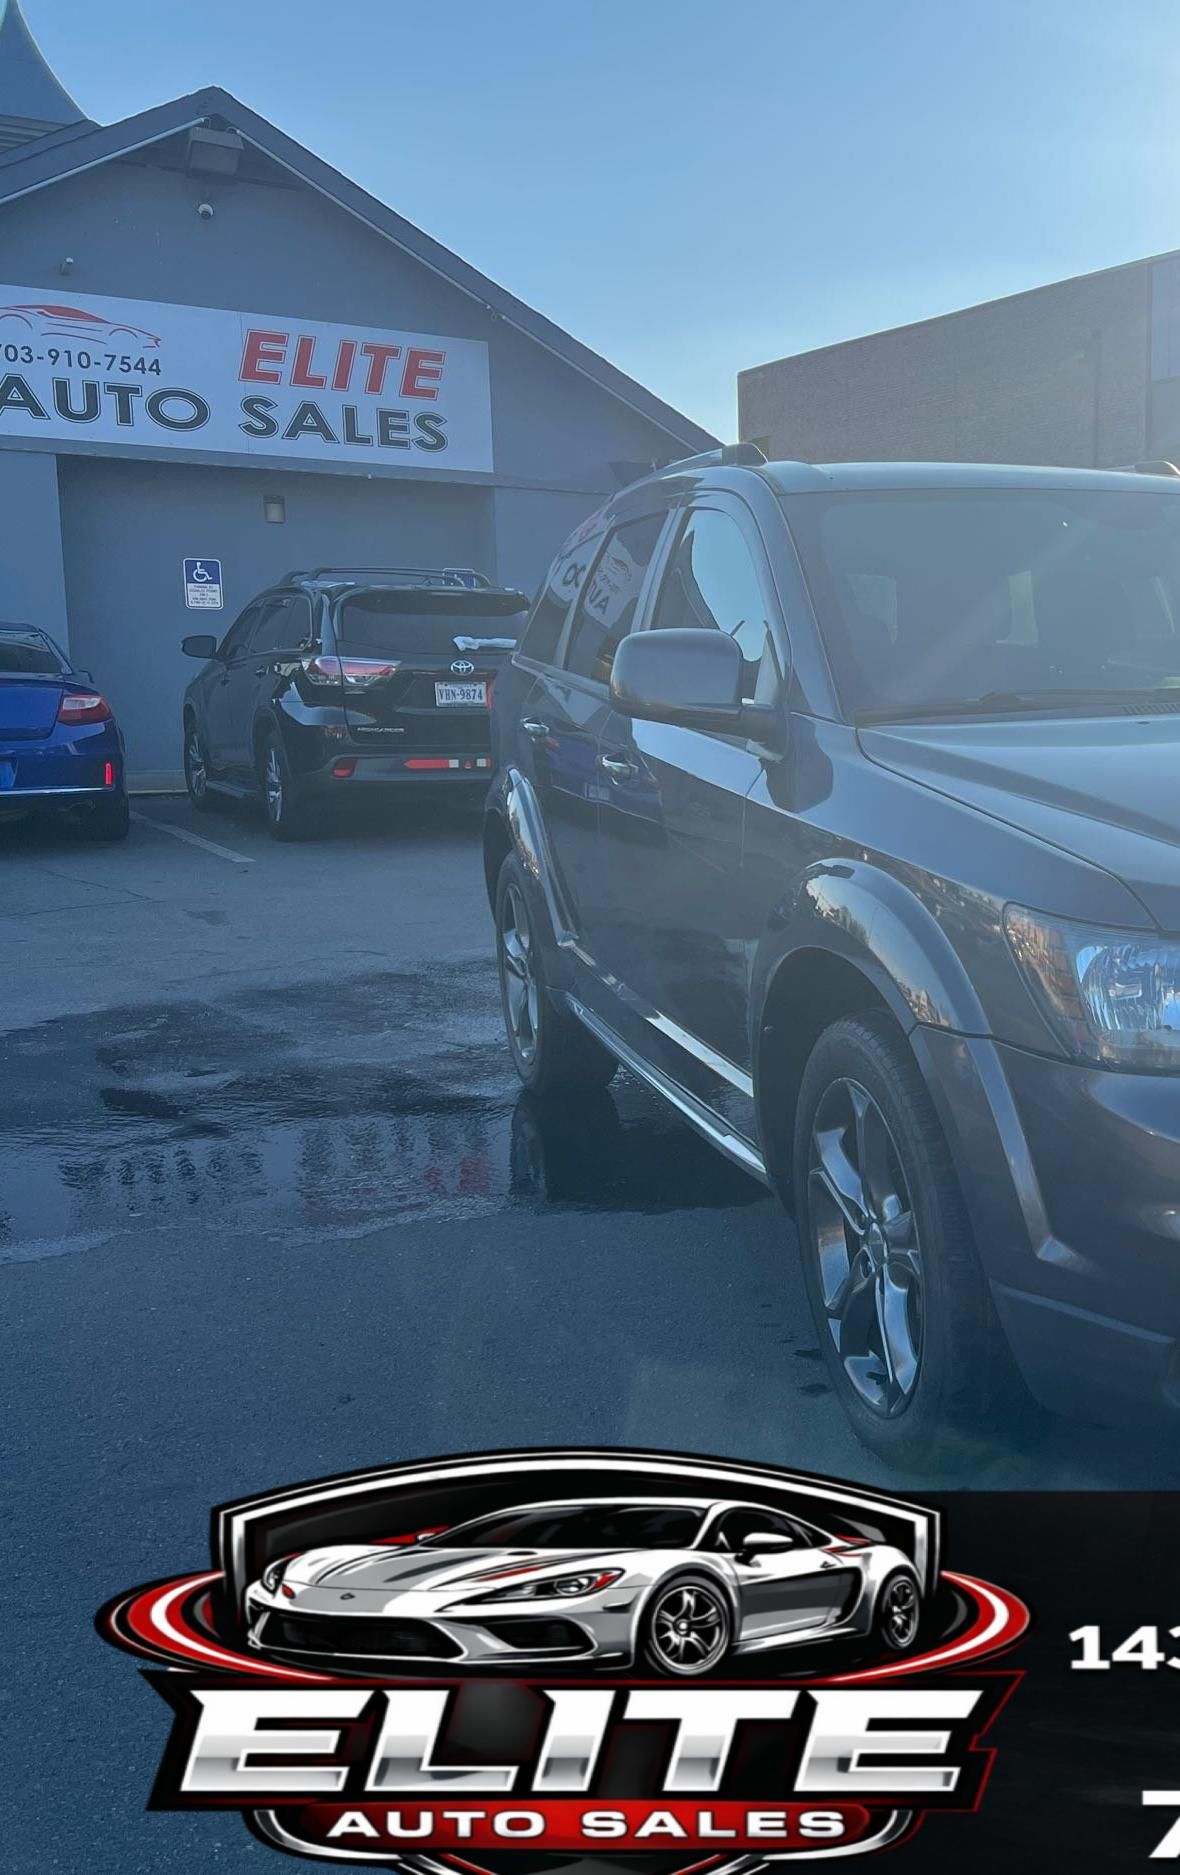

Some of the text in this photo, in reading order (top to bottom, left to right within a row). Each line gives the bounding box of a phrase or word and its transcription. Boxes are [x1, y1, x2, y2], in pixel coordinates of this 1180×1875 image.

[0, 344, 161, 375] 03-910-7544
[238, 329, 446, 400] ELITE
[0, 373, 449, 453] AUTO SALES
